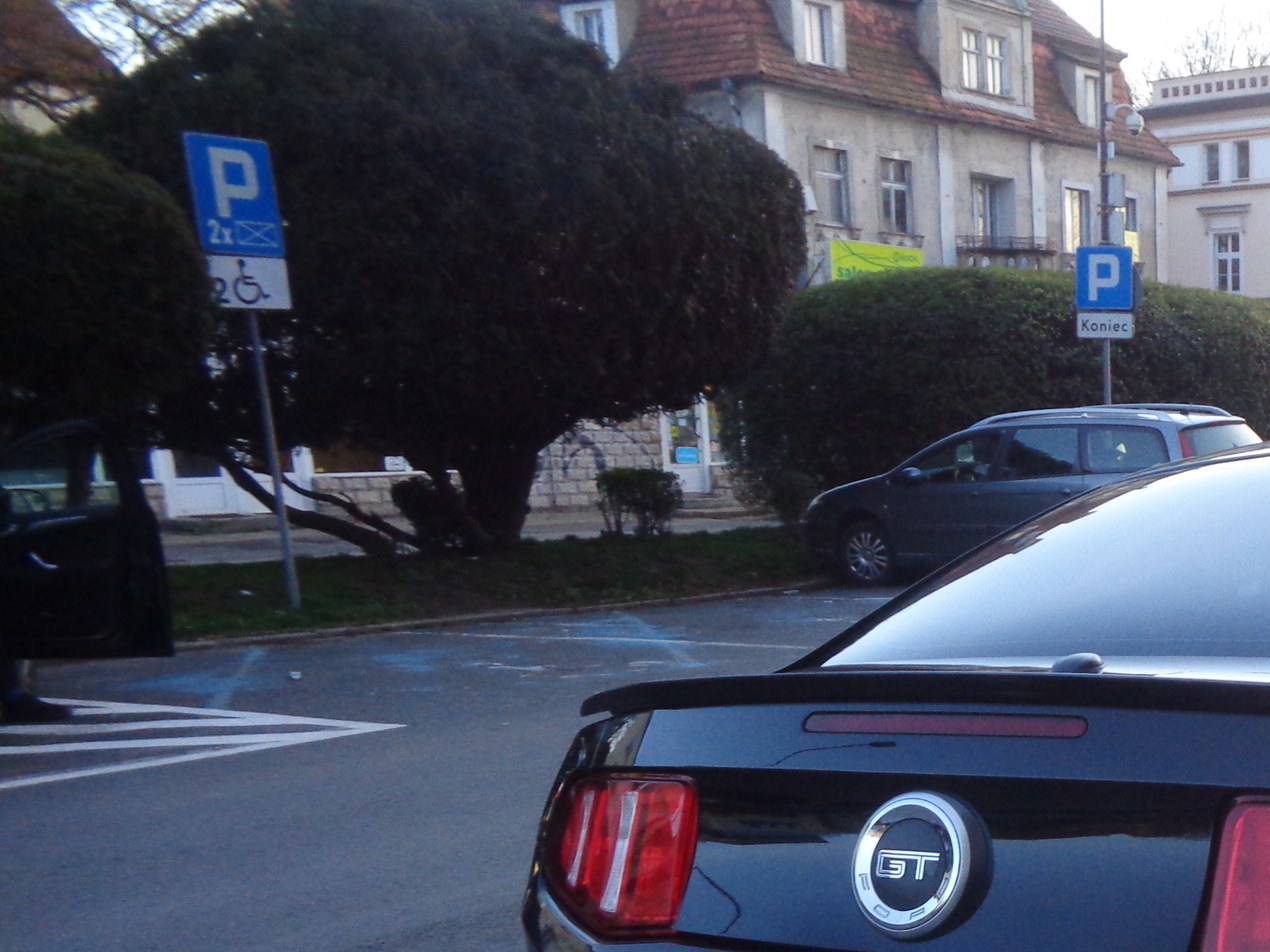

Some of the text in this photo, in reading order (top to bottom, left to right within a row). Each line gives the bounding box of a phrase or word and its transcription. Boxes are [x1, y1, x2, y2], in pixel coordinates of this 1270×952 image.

[208, 147, 260, 218] P
[1088, 254, 1120, 301] P
[1081, 319, 1128, 332] Koniec
[875, 849, 941, 881] GT
